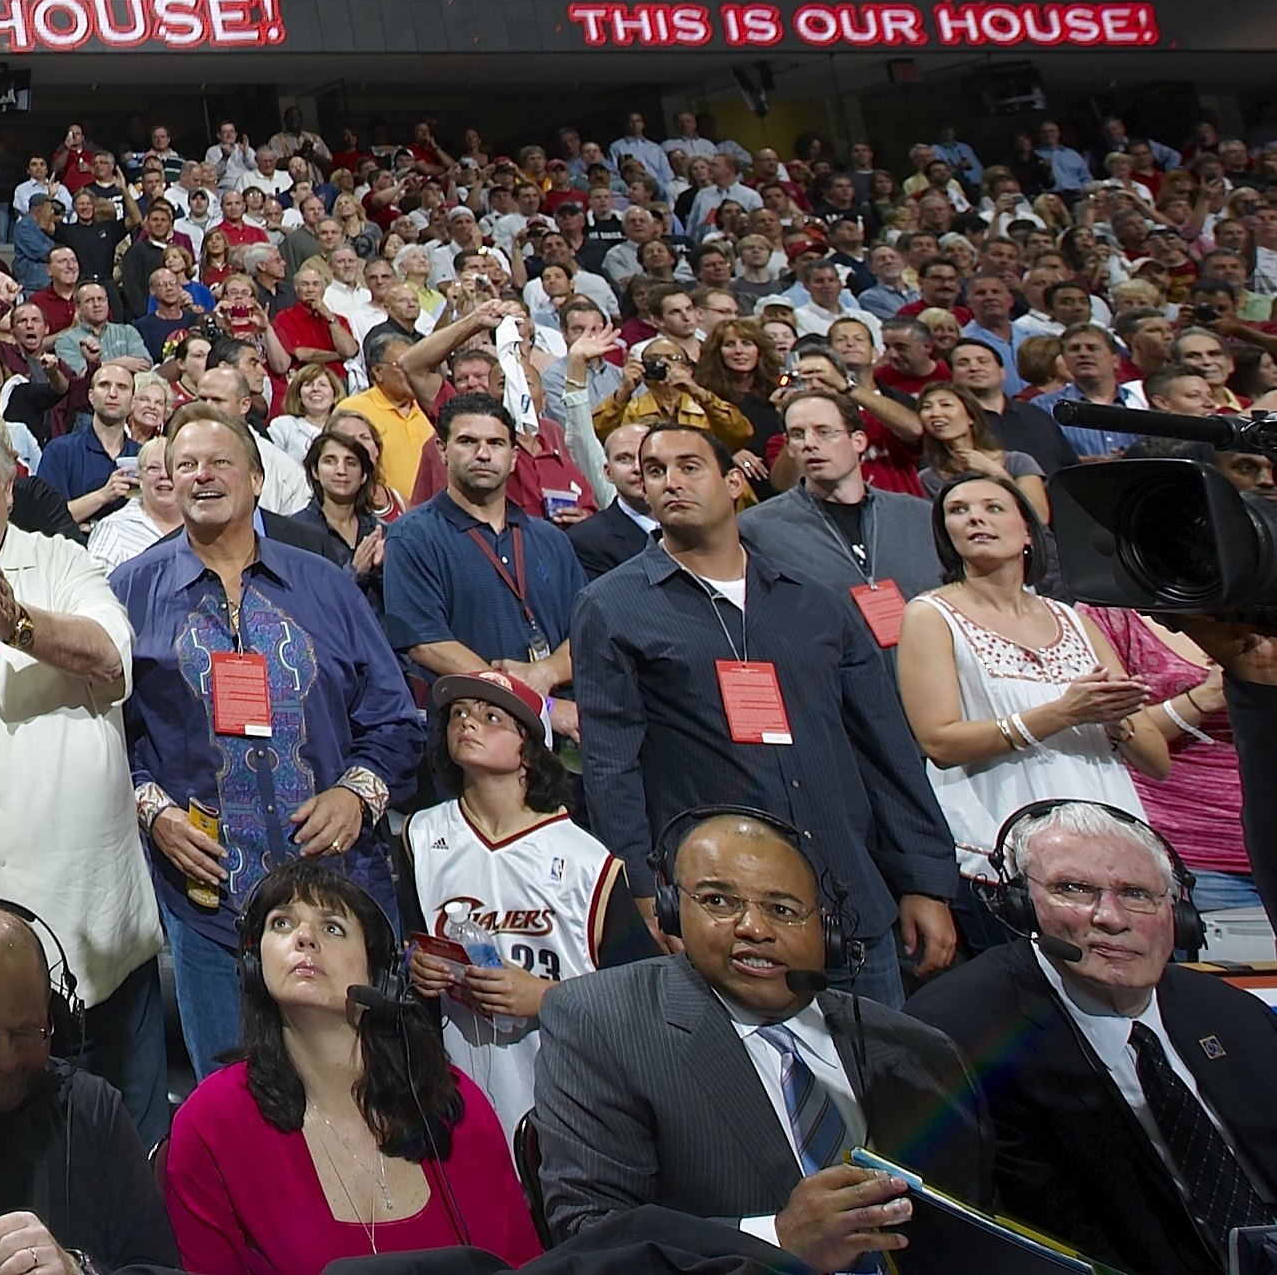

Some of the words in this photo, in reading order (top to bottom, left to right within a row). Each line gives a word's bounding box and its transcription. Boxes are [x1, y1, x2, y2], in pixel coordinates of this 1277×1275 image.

[572, 6, 708, 42] THIS
[725, 6, 777, 42] IS
[796, 6, 920, 43] OUR
[939, 5, 1156, 44] HOUSE!
